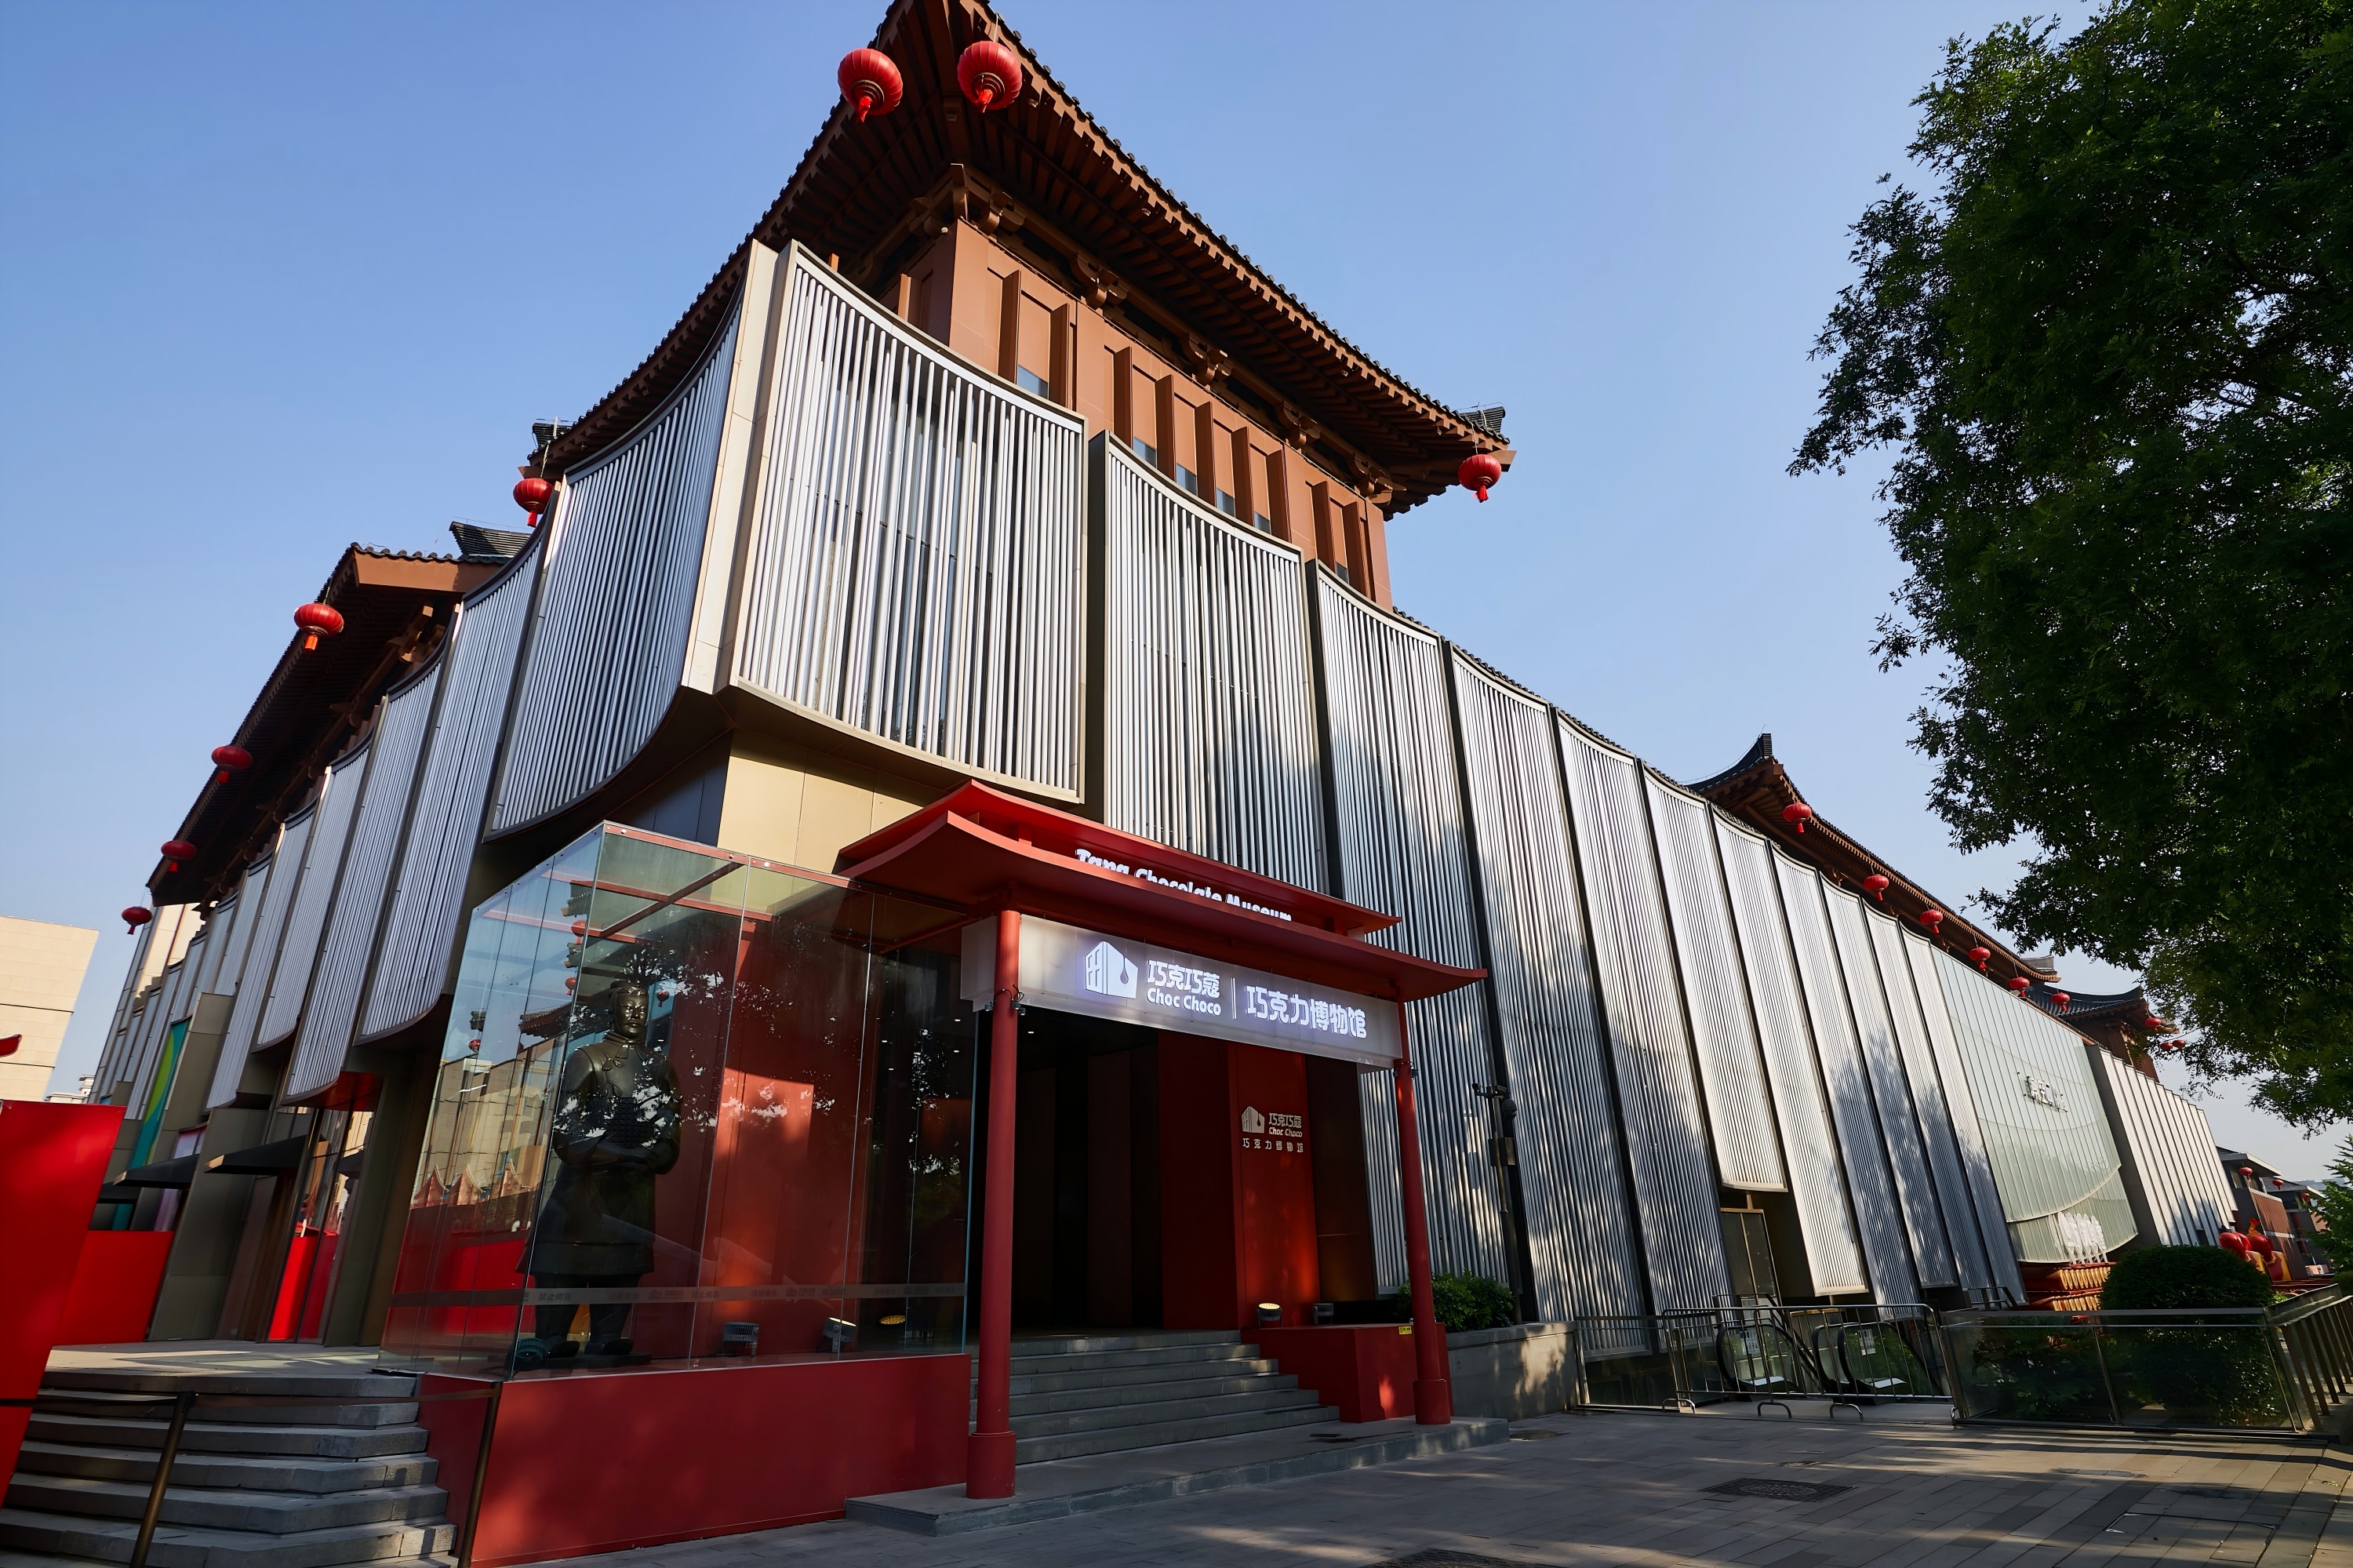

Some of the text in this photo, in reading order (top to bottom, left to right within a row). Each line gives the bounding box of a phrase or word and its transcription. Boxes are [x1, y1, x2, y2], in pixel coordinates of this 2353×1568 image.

[1147, 960, 1220, 998] 巧克巧蔻
[1147, 988, 1221, 1016] Choc Choco
[1246, 985, 1367, 1039] 巧克力博物馆
[1269, 1126, 1303, 1137] Choc Choco
